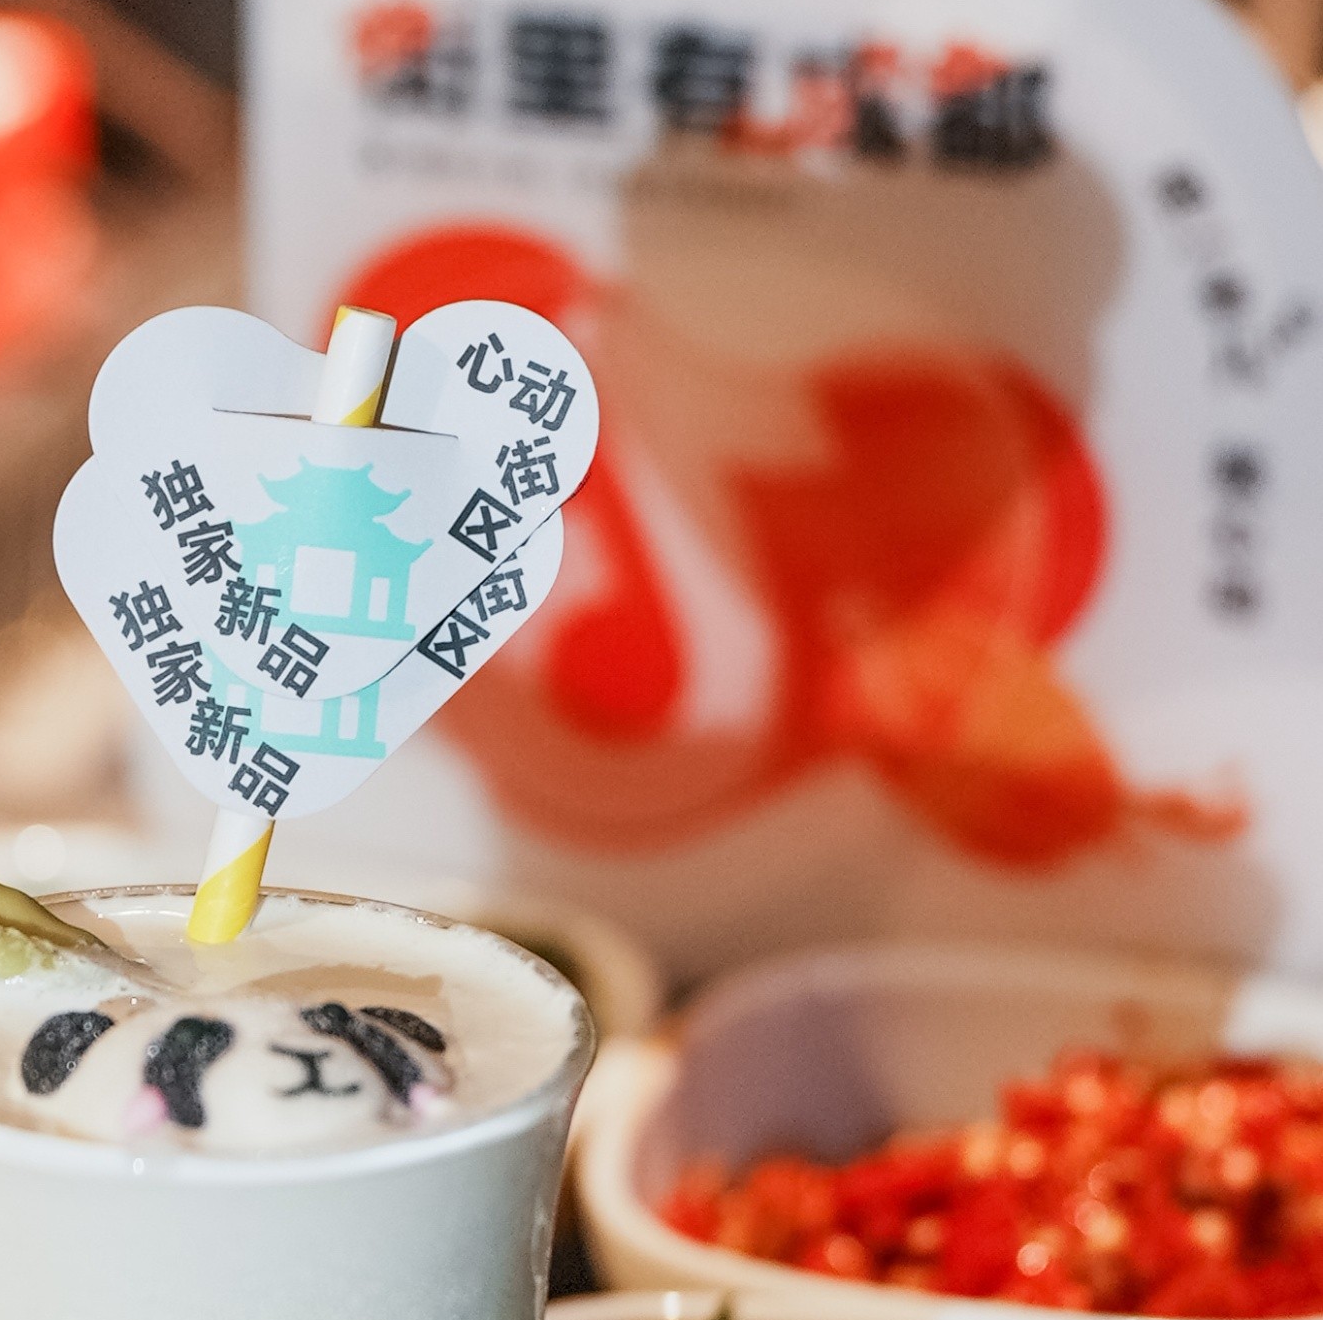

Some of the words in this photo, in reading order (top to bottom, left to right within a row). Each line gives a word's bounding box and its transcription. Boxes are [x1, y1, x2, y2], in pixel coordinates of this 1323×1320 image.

[456, 332, 577, 563] 心动街区
[140, 459, 330, 698] 独家新品
[108, 579, 302, 817] 独家新品
